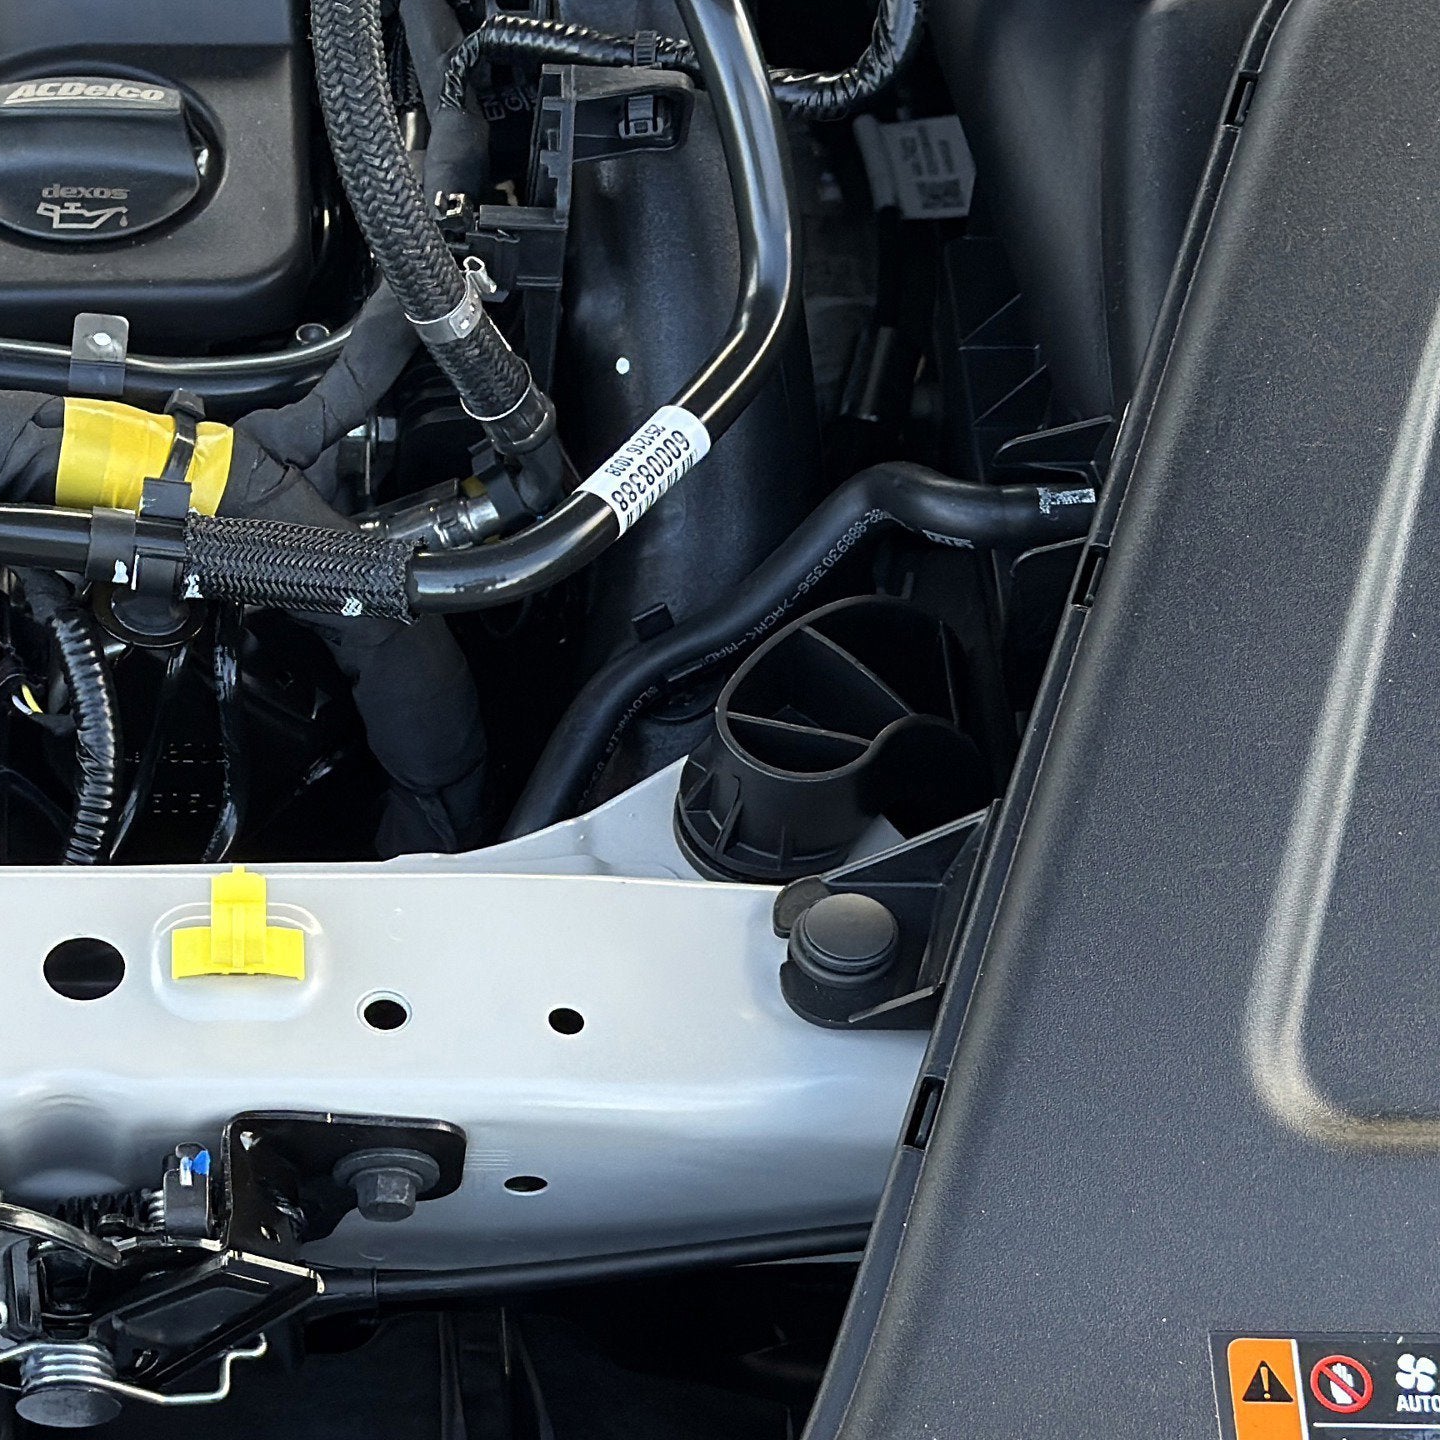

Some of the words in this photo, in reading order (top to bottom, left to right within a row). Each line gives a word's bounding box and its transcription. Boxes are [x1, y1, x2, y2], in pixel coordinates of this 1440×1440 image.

[6, 81, 165, 102] ACDelco
[42, 183, 130, 199] dexos
[611, 430, 690, 512] 60008388
